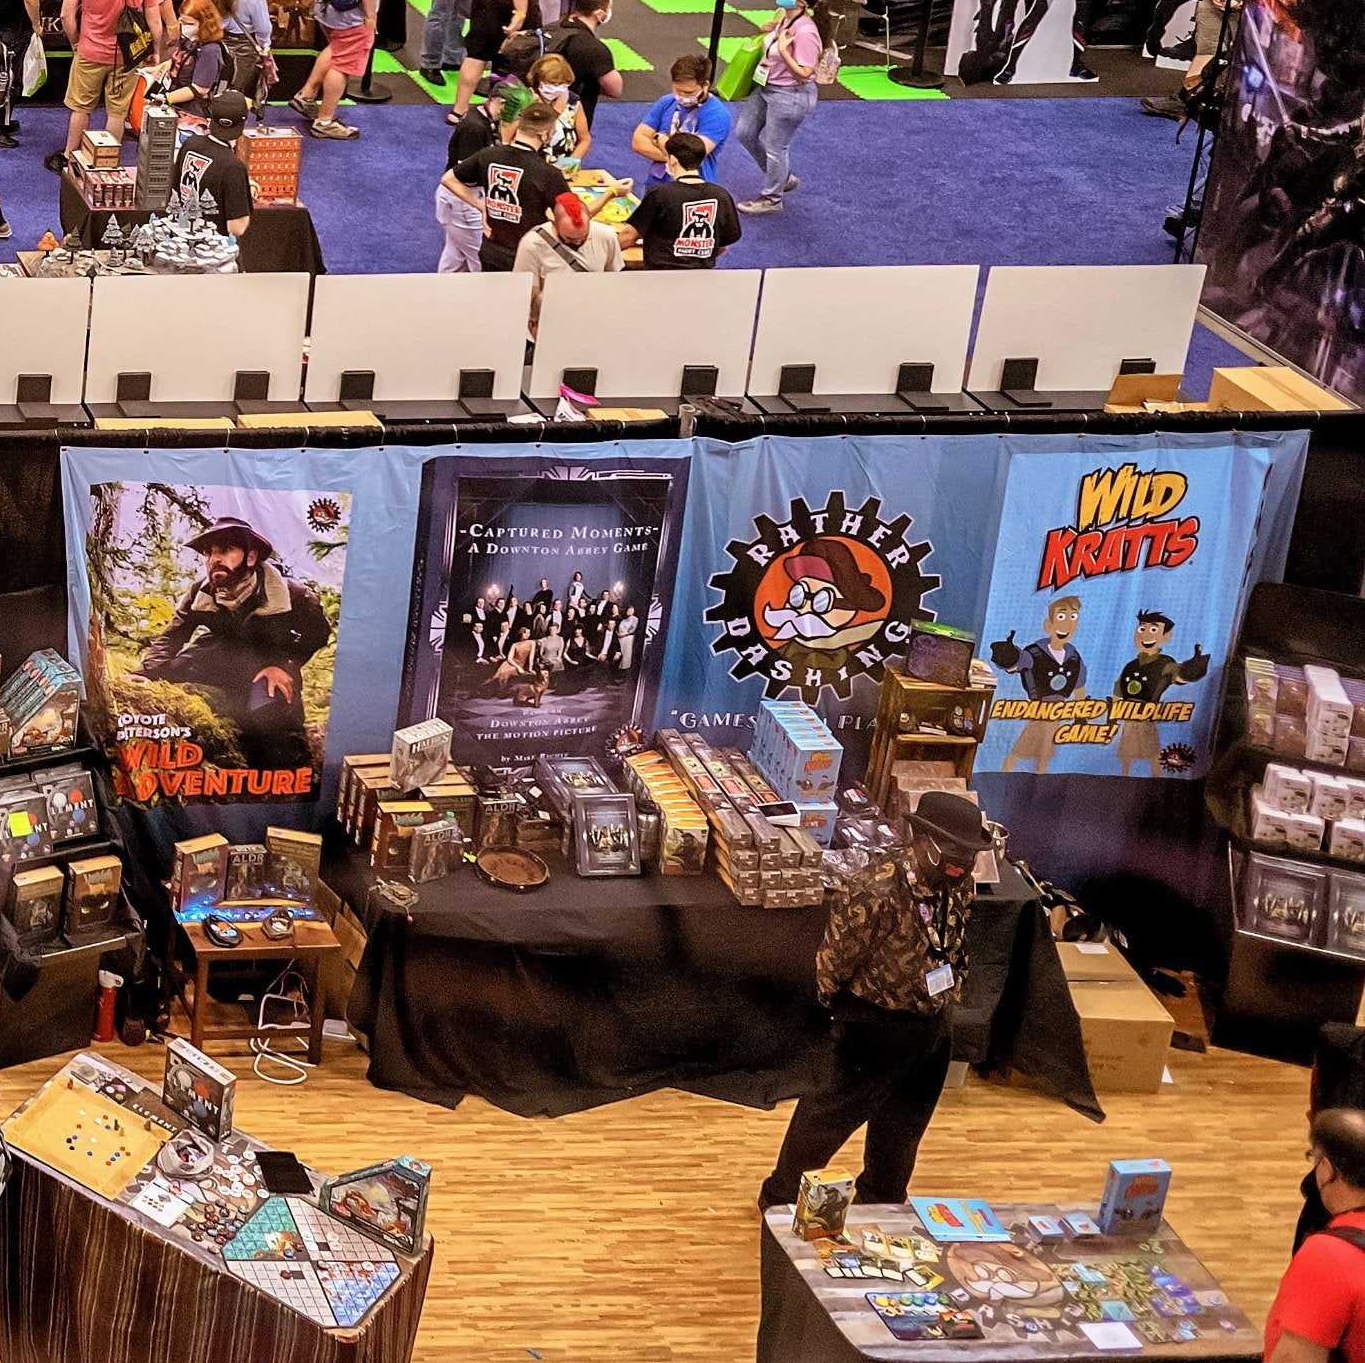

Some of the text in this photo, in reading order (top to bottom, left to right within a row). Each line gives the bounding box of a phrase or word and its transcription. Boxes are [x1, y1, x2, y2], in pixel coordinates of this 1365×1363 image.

[1077, 463, 1188, 529] WILD
[751, 510, 912, 567] RATHER
[1037, 516, 1200, 591] KRATTS
[725, 618, 913, 688] DASHING
[991, 698, 1193, 722] ENDANGERED WILDLIFE
[1054, 722, 1119, 745] GAME!
